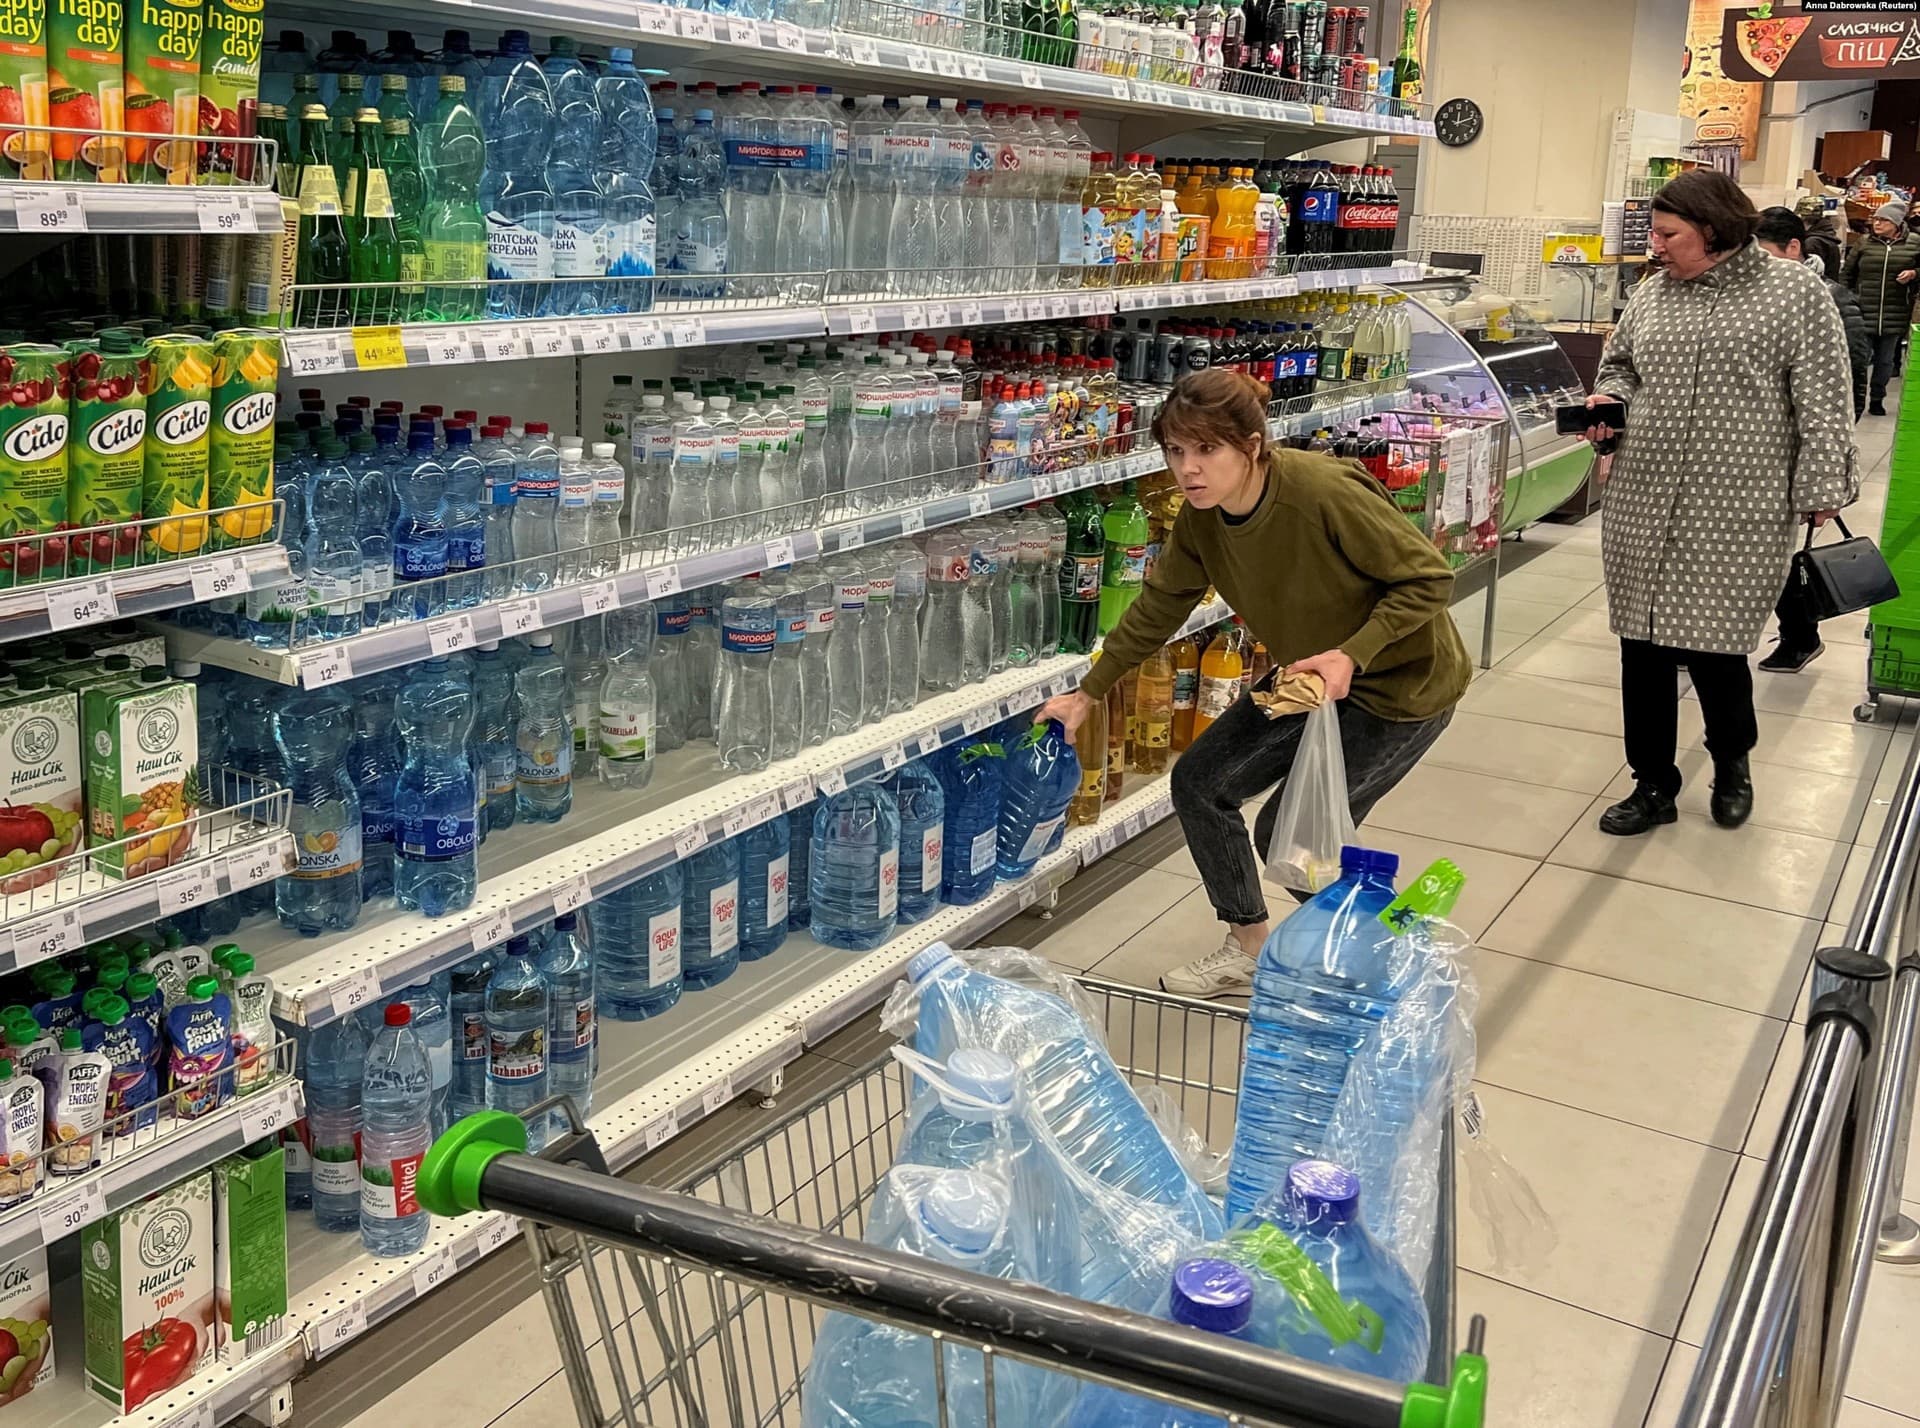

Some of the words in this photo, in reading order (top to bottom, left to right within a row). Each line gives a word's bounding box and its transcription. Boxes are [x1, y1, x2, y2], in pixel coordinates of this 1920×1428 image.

[59, 0, 123, 26] happ
[142, 2, 203, 33] happ
[208, 5, 263, 42] happ
[77, 20, 123, 51] day
[158, 33, 199, 61] day
[222, 33, 260, 63] day
[488, 233, 538, 245] РПАТСЬКА
[1557, 255, 1582, 263] OATS
[164, 411, 208, 441] Cido
[233, 402, 274, 433] Cido
[13, 421, 65, 457] Cido
[98, 416, 140, 451] Cido
[214, 577, 228, 592] 59
[74, 605, 89, 620] 64
[11, 768, 43, 785] Наш
[43, 760, 64, 775] Сік
[136, 760, 163, 775] Наш
[249, 866, 263, 879] 43
[180, 890, 195, 904] 35
[655, 927, 677, 944] aqua
[40, 938, 56, 954] 43
[348, 992, 360, 1005] 25
[190, 1010, 214, 1022] JAFFA
[184, 1018, 222, 1037] CRAZY
[187, 1029, 226, 1053] FRUIT
[111, 1049, 141, 1065] RUIT
[69, 1065, 101, 1080] JAFFA
[71, 1082, 98, 1093] TROPIC
[69, 1094, 98, 1106] ENERGY
[11, 1104, 36, 1120] TROPIC
[12, 1114, 38, 1133] ENERGY
[261, 1116, 275, 1130] 30
[400, 1160, 417, 1205] Vittel
[64, 1210, 81, 1227] 30
[3, 1267, 31, 1289] Сік
[138, 1267, 172, 1296] Наш
[173, 1255, 197, 1278] Сік
[151, 1277, 185, 1298] ТОМАТНИЙ
[154, 1286, 185, 1311] 100%
